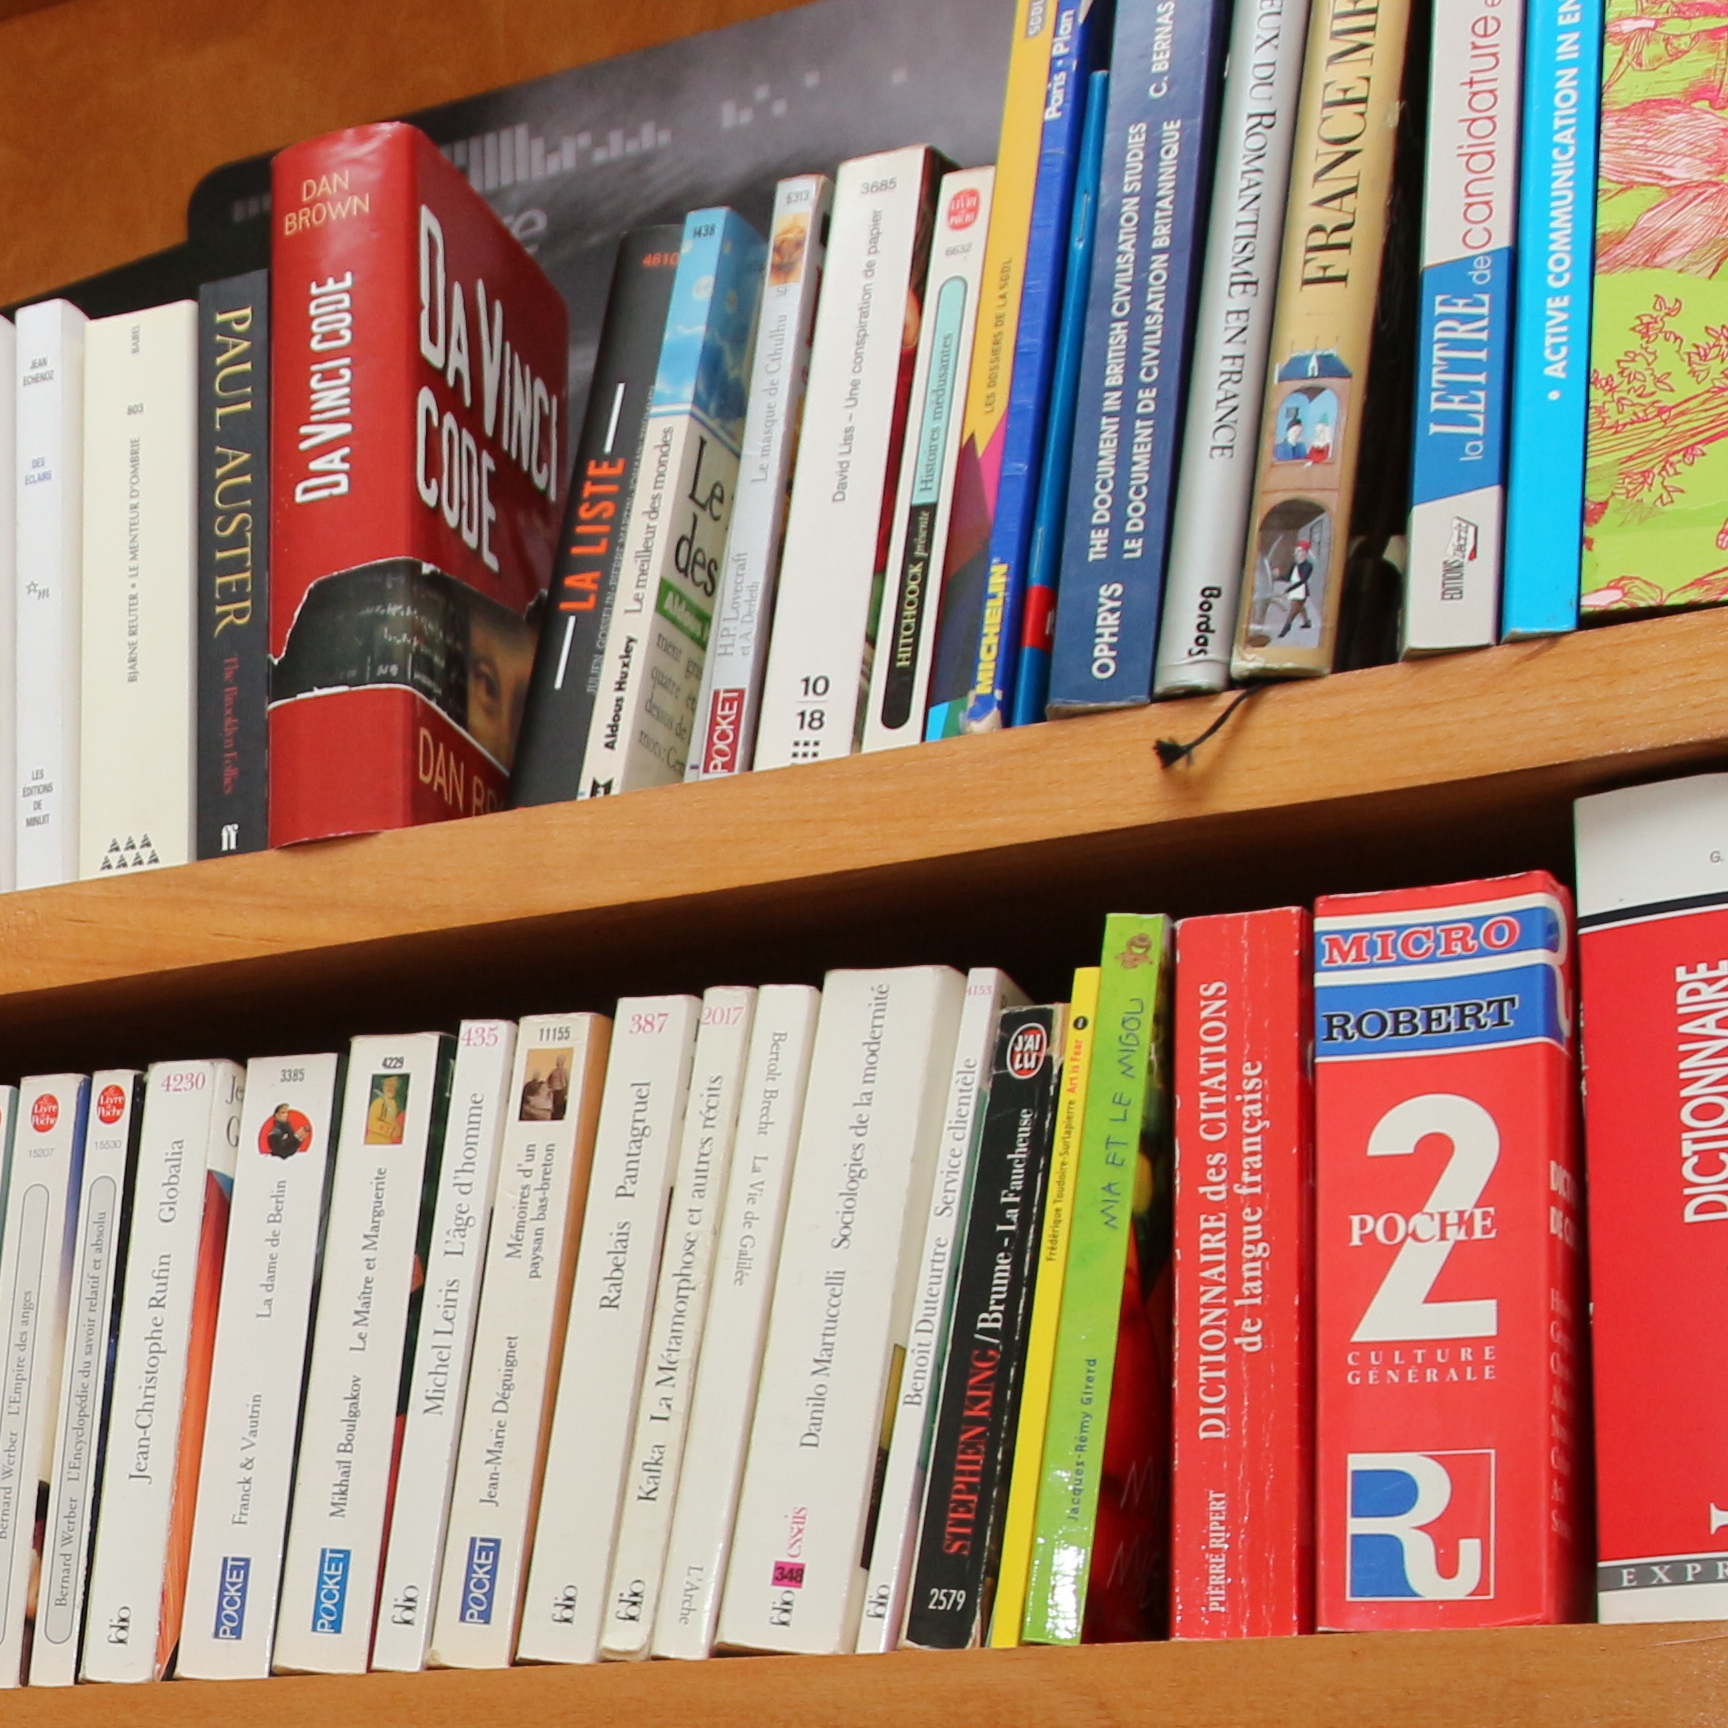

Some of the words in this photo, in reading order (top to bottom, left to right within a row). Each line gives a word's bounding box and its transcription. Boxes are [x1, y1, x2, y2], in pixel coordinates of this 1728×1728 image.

[1555, 31, 1581, 62] IN
[1123, 121, 1148, 193] STUDIES
[1456, 14, 1502, 251] candidature
[301, 170, 350, 203] DAN
[1546, 66, 1579, 289] COMMUNICATION
[284, 193, 370, 237] BROWN
[1112, 194, 1140, 317] CIVILISATION
[1467, 254, 1492, 285] de
[309, 270, 354, 353] CODE
[1544, 296, 1570, 378] ACTIVE
[214, 306, 252, 432] PAUL
[419, 204, 471, 407] DA
[477, 278, 557, 502] VINCI
[1104, 320, 1129, 385] BRITISH
[1429, 293, 1491, 436] LETTRE
[299, 356, 353, 451] VINCI
[1102, 391, 1123, 413] IN
[295, 447, 351, 504] DA
[416, 386, 499, 573] CODE
[1091, 415, 1122, 525] DOCUMENT
[1459, 440, 1484, 462] la
[213, 445, 252, 638] AUSTER
[571, 457, 626, 556] LISTE
[1087, 526, 1111, 563] THE
[559, 570, 602, 612] LA
[896, 561, 925, 668] HITCHCOCK
[1187, 586, 1223, 657] Bordas
[615, 634, 639, 693] Huxley
[975, 562, 1009, 694] MICHELIN
[1091, 582, 1124, 680] OPHRYS
[604, 691, 627, 750] Aldous
[1322, 915, 1521, 965] MICRO
[628, 1012, 669, 1034] 387
[1322, 996, 1518, 1042] ROBERT
[1199, 979, 1229, 1142] CITATIONS
[1675, 960, 1728, 1223] DICTIONNAIRE
[158, 1138, 185, 1224] Globalia
[599, 1221, 631, 1311] Rabelais
[615, 1081, 652, 1199] Pantagruel
[1198, 1151, 1228, 1202] des
[1349, 1207, 1497, 1246] POCHE
[1350, 1093, 1500, 1342] 2
[148, 1253, 172, 1311] Rufin
[1198, 1211, 1229, 1440] DICTIONNAIRE
[1347, 1345, 1497, 1365] CULTURE
[128, 1315, 166, 1484] Jean-Christophe
[963, 1348, 998, 1421] KING
[1347, 1364, 1497, 1385] GÉNÉRALE
[337, 1374, 363, 1454] Boulgakov
[329, 1457, 353, 1520] Mikhaïl
[636, 1443, 666, 1502] Kafka
[944, 1425, 990, 1556] STEPHEN
[927, 1589, 966, 1612] 2579
